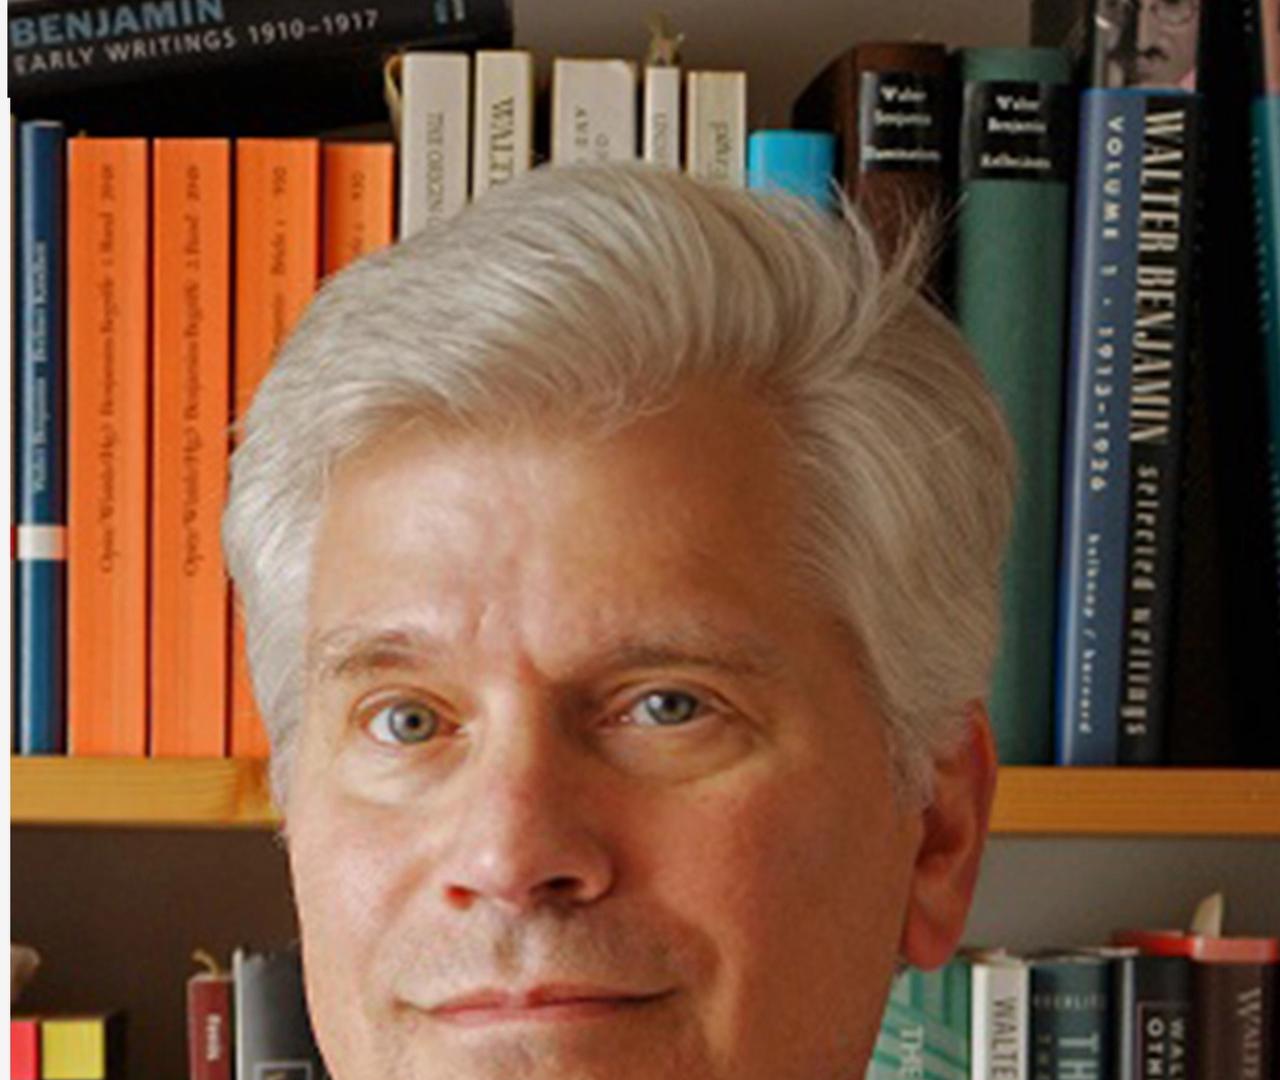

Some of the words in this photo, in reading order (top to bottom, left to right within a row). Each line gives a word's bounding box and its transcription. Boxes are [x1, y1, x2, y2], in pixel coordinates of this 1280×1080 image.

[10, 0, 224, 48] BENJAMIN
[13, 46, 94, 76] EARLY
[104, 29, 238, 65] WRITINGS
[490, 97, 515, 188] WALT
[987, 116, 1047, 134] Benjamin
[1102, 115, 1124, 240] VOLUME
[1139, 109, 1186, 253] WALTER
[1128, 265, 1177, 446] BENJAMIN
[1133, 464, 1159, 592] selected
[1120, 606, 1154, 736] writings
[900, 1023, 924, 1079] THE
